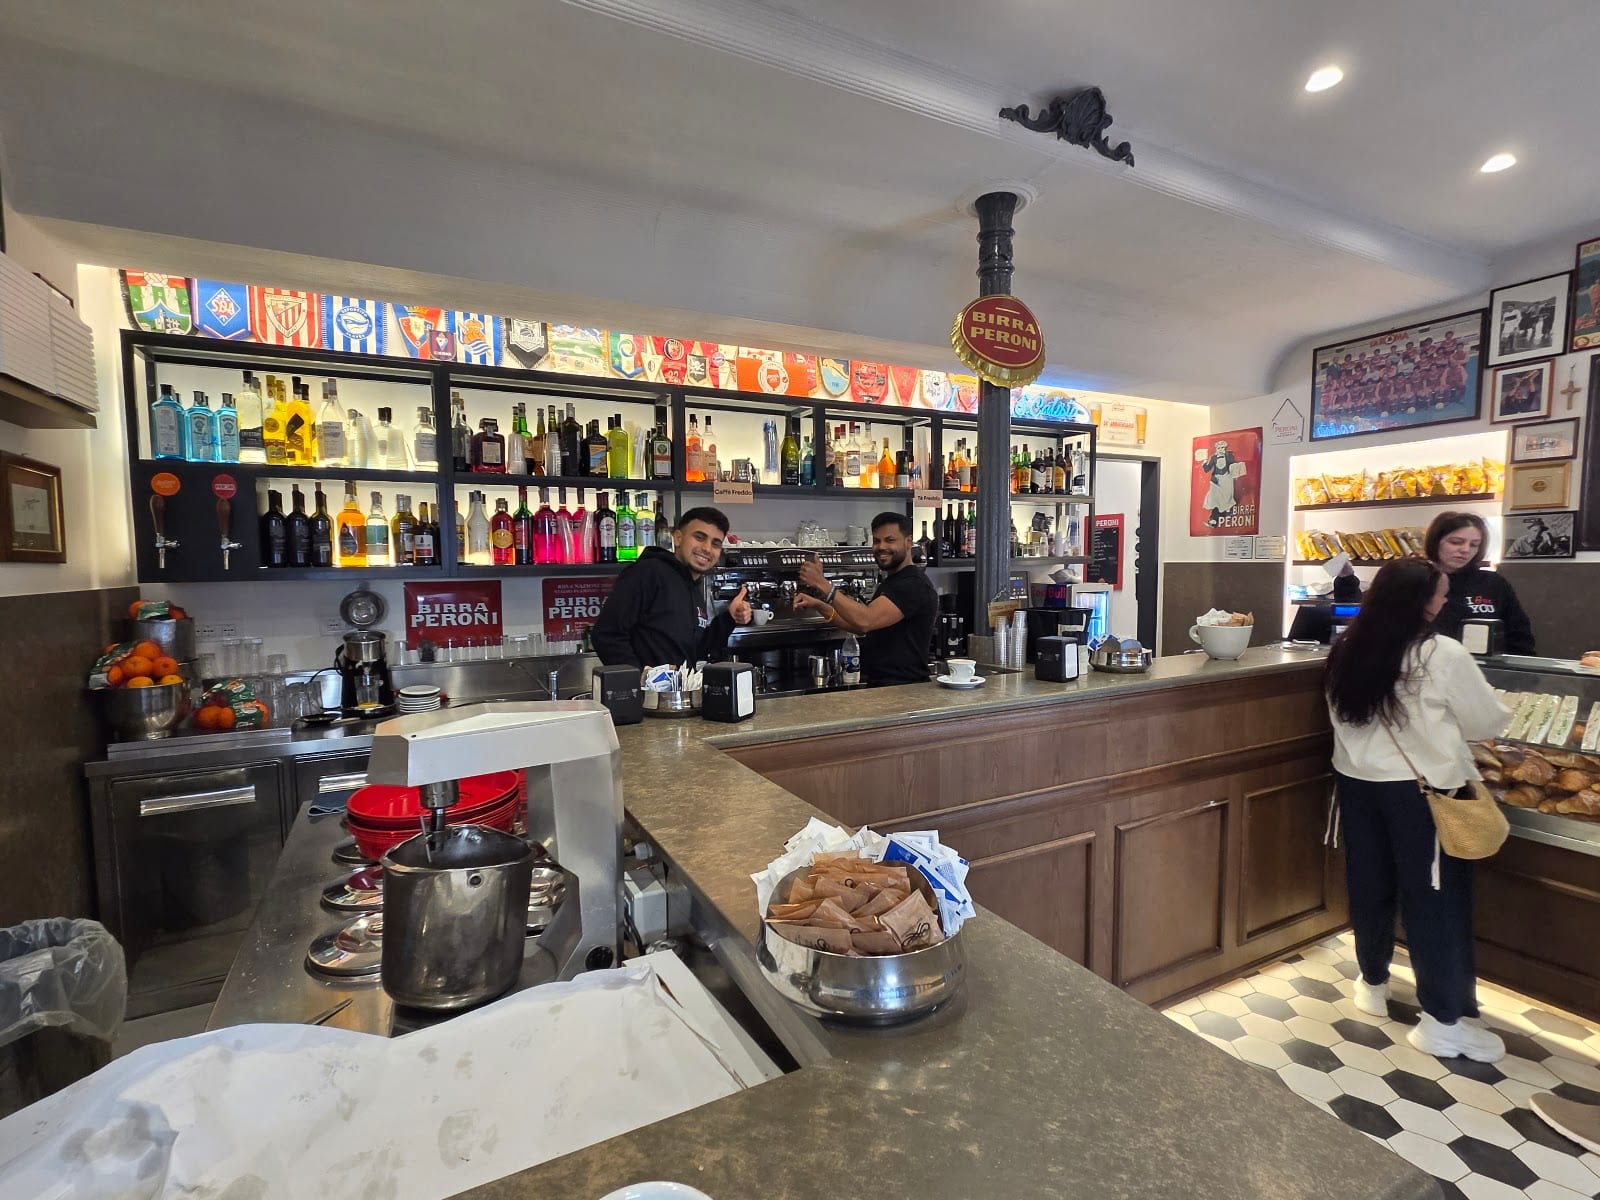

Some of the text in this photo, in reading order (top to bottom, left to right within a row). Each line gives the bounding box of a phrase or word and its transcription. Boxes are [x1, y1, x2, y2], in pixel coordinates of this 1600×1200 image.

[972, 311, 1036, 335] BIRRA
[970, 326, 1037, 351] PERONI
[1232, 504, 1255, 515] BIRRA
[1095, 519, 1119, 527] PERONI
[1218, 515, 1255, 528] PERONI
[418, 603, 489, 614] BIRRA
[548, 606, 601, 619] PERO
[1468, 604, 1495, 613] YOU
[411, 612, 498, 628] PERONI
